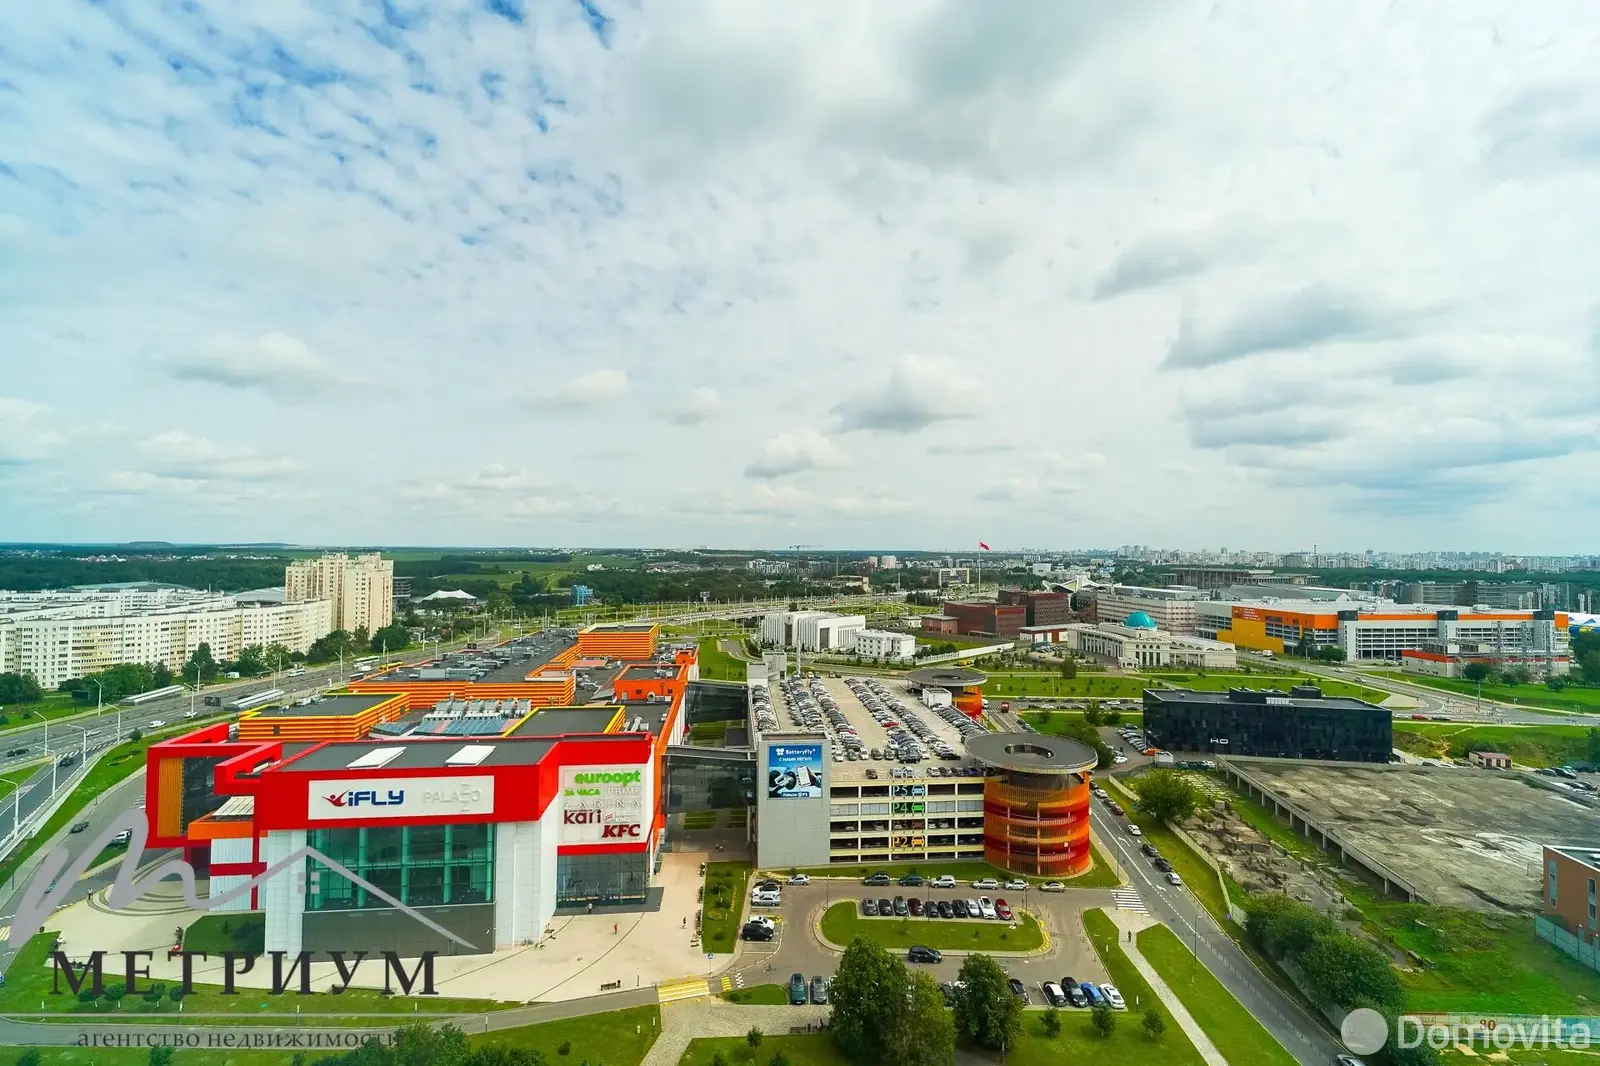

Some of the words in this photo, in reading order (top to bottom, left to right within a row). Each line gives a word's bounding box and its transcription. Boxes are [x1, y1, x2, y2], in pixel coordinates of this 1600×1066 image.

[575, 770, 640, 787] euroopt
[892, 784, 907, 796] P5
[348, 790, 404, 806] iFLY
[564, 798, 640, 809] ZARINA
[892, 802, 908, 813] P4
[564, 808, 601, 825] kari
[602, 823, 640, 838] KFC
[892, 836, 907, 847] P2
